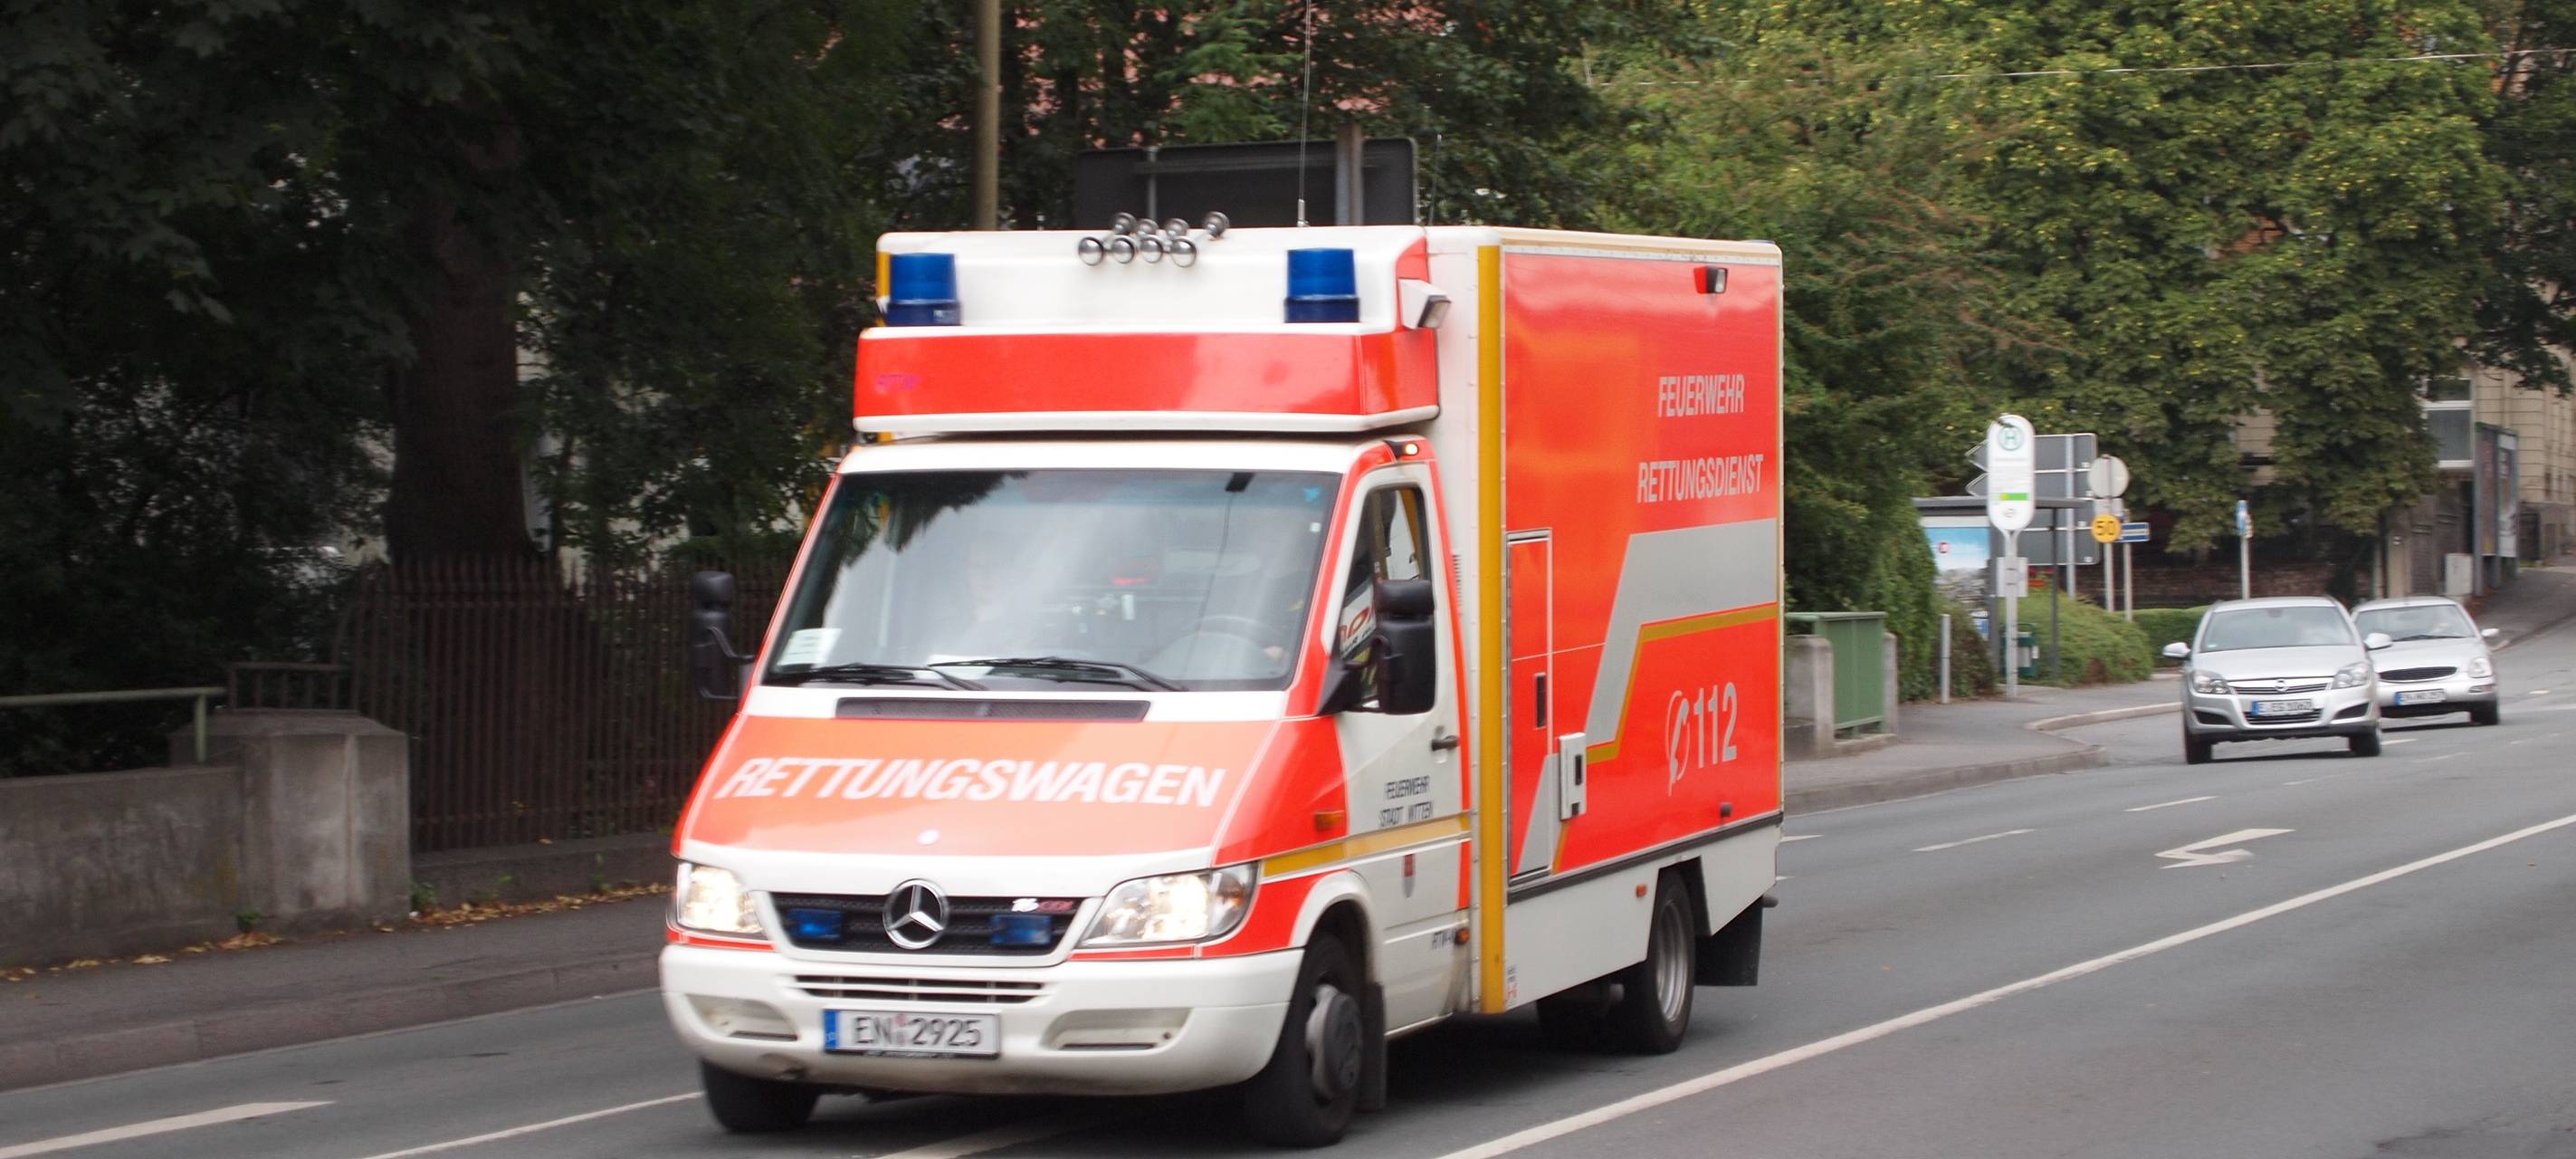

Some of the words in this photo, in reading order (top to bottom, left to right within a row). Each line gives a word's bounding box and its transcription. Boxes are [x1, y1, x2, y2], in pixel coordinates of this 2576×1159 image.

[1658, 373, 1745, 418] FEUERWEHR
[1636, 454, 1764, 503] RETTUNGSDIENST
[2095, 520, 2116, 536] 50
[1693, 681, 1738, 769] 112
[714, 757, 1226, 808] RETTUNGSWAGEN
[1384, 774, 1430, 800] FEUERWEHR
[853, 1015, 893, 1044] EN
[909, 1017, 982, 1048] 2925
